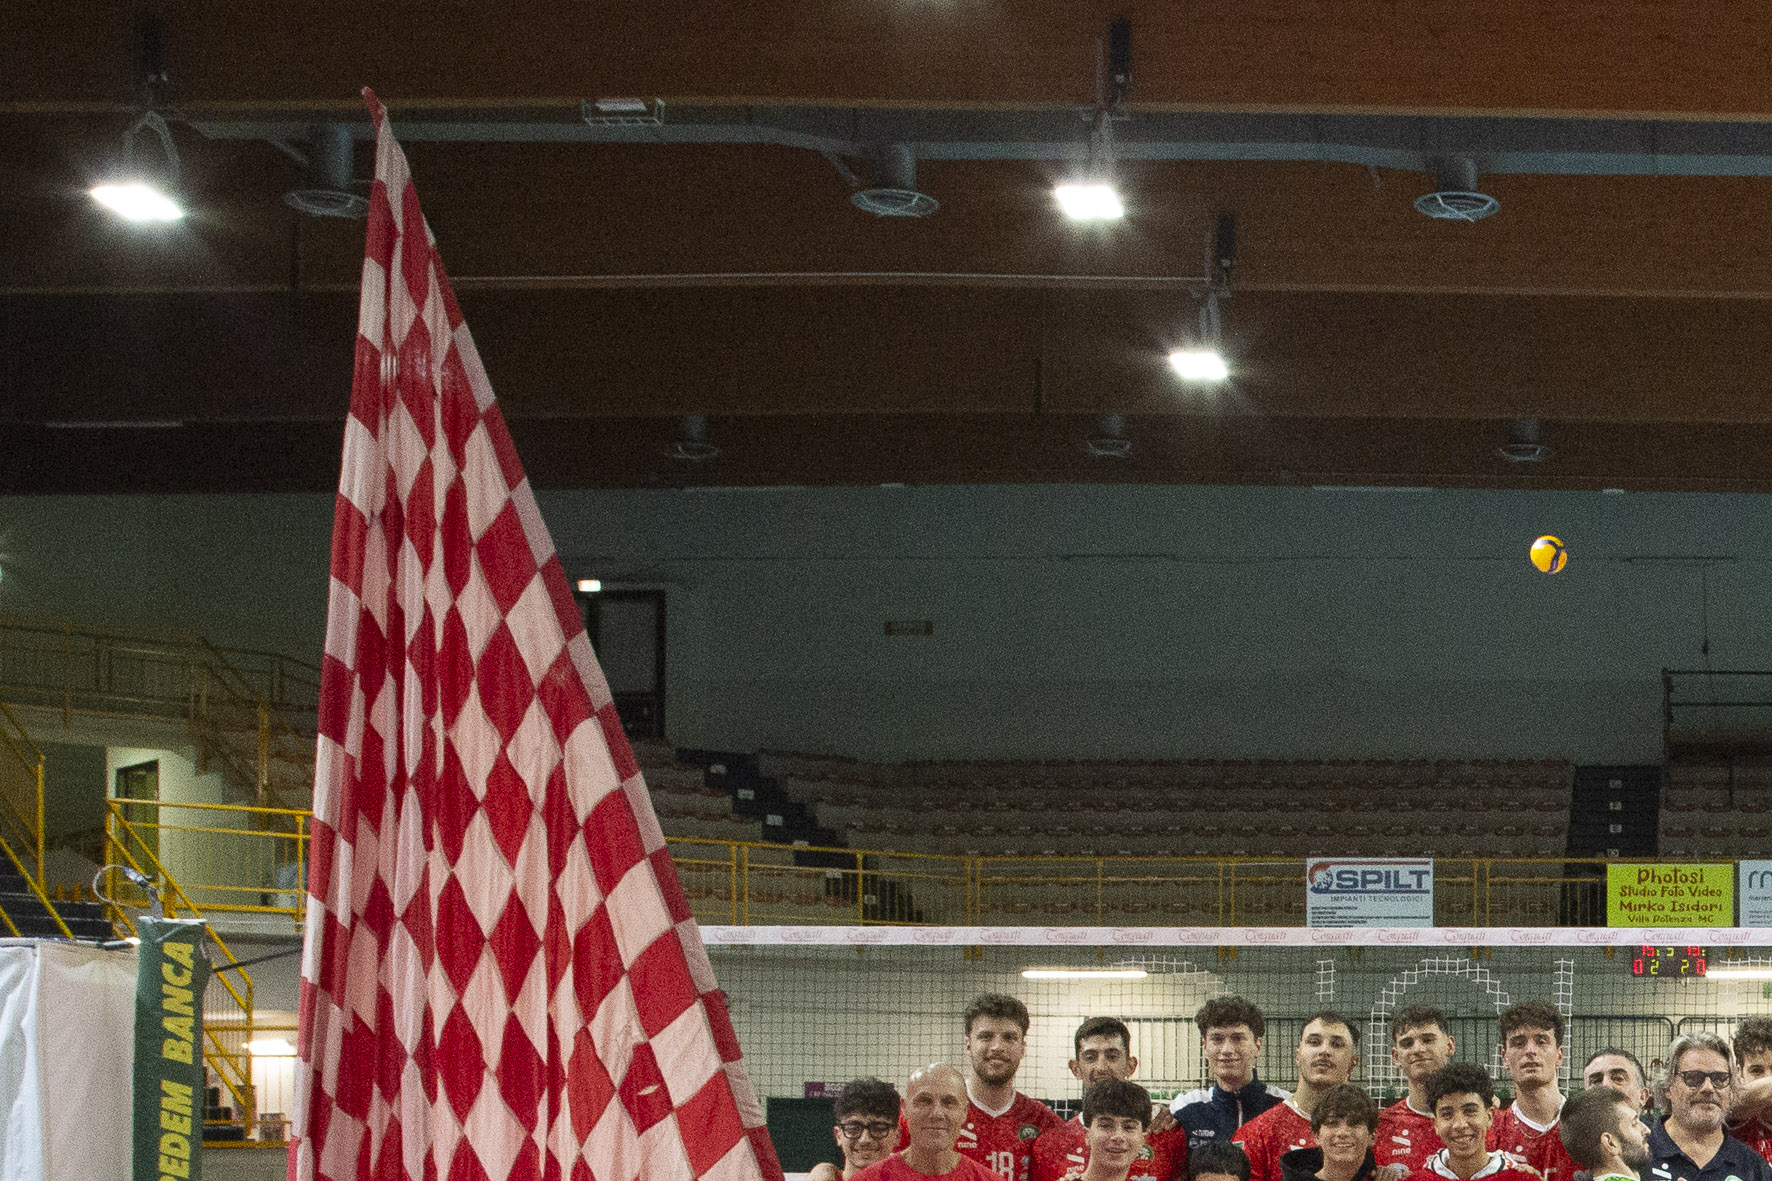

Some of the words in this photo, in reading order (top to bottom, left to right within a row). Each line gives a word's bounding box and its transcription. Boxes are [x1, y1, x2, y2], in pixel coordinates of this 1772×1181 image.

[1336, 870, 1430, 889] SPILT
[1620, 885, 1657, 898] Studio
[1661, 885, 1685, 898] Foto
[1687, 885, 1723, 898] Video
[1619, 900, 1665, 913] Mirko
[1670, 900, 1723, 913] Isidori
[161, 942, 195, 1066] BANCA
[1392, 1146, 1412, 1156] nine
